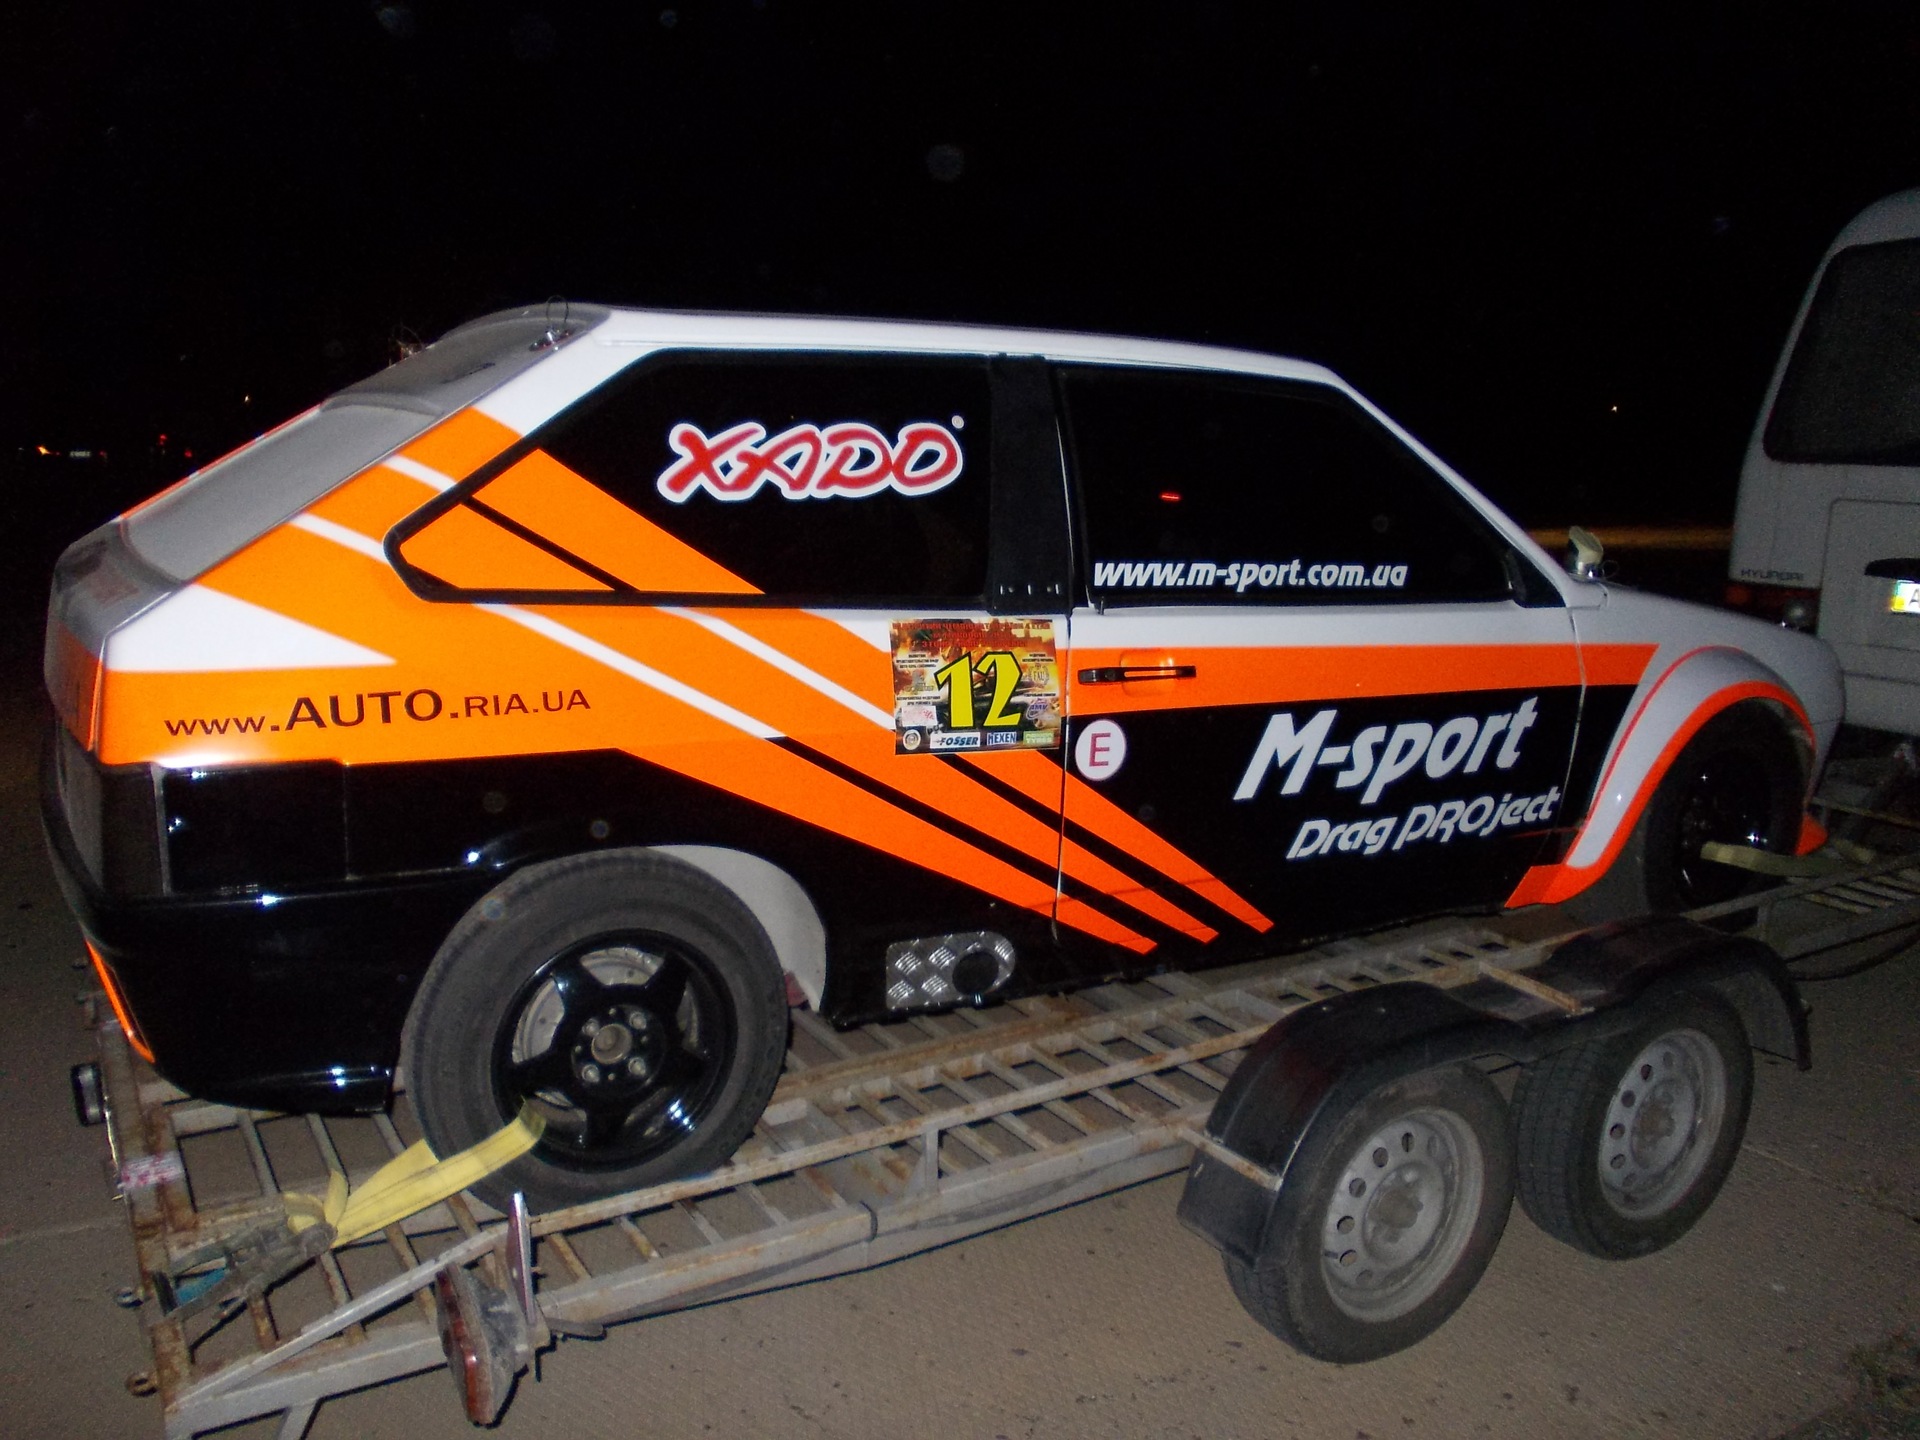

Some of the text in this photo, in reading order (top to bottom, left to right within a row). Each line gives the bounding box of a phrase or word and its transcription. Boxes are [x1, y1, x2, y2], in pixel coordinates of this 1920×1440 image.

[1094, 559, 1408, 592] www.m-sport.com.ua
[934, 651, 1023, 730] 12
[164, 689, 590, 736] www.AUTO.RIA.UA
[939, 736, 979, 746] FOSSER
[1089, 732, 1111, 767] E
[1233, 696, 1538, 804] M-sport
[1286, 817, 1398, 859] Drag
